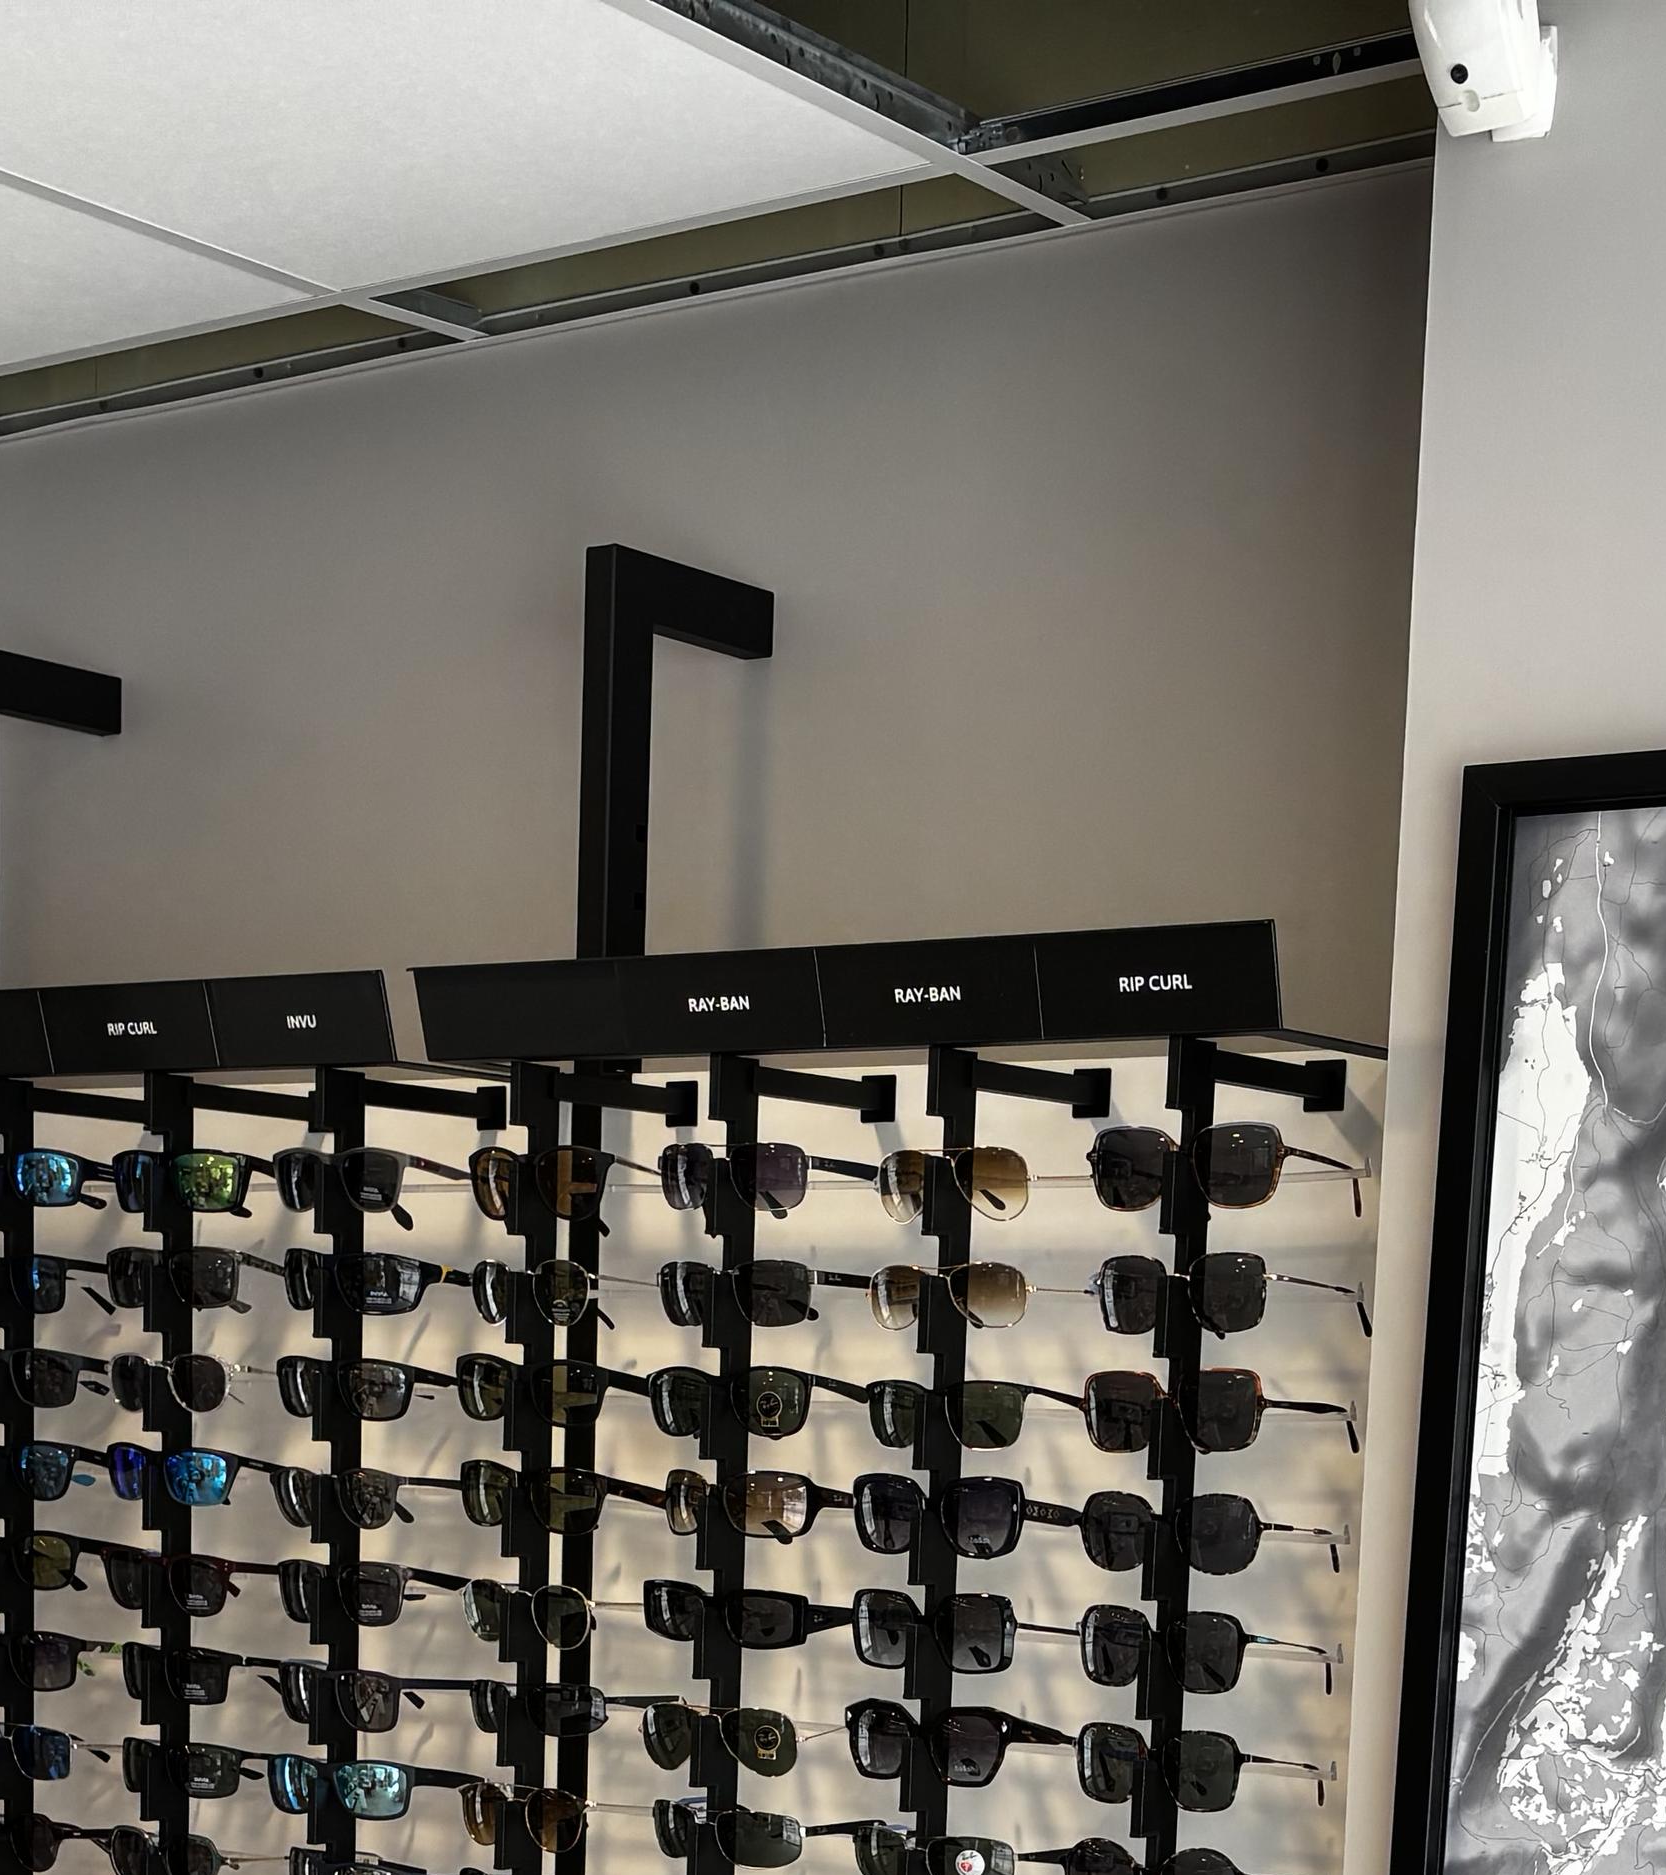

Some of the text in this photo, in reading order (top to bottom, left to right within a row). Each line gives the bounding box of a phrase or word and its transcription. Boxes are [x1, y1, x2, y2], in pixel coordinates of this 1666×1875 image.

[1118, 973, 1193, 992] RIP CURL
[894, 985, 962, 1004] RAY-BAN
[687, 995, 750, 1013] RAY-BAN
[107, 1022, 158, 1036] RIP CURL
[286, 1014, 317, 1029] INVU
